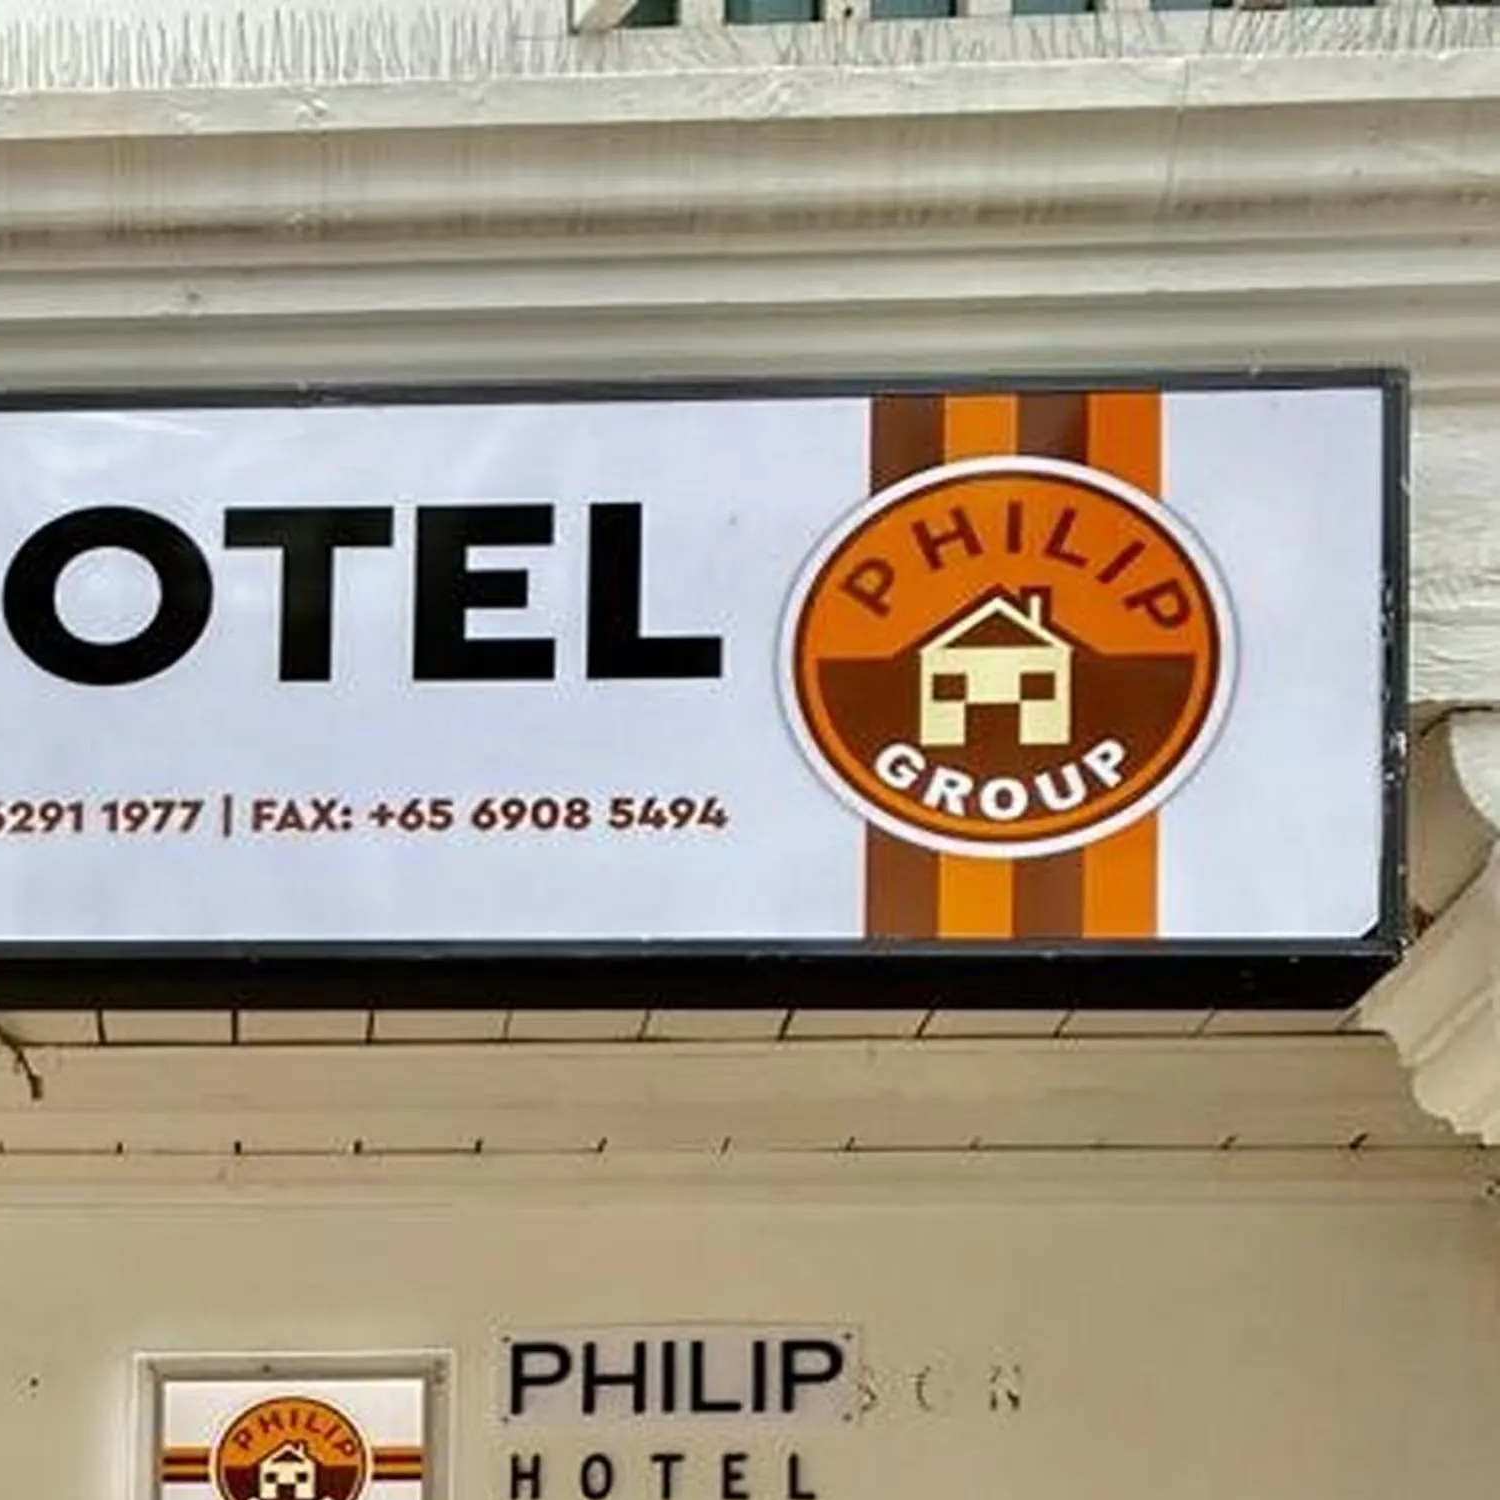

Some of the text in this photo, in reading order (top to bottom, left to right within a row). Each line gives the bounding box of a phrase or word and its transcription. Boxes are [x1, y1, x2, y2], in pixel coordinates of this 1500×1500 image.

[839, 501, 1192, 630] PHILIP
[100, 799, 205, 834] 1977
[251, 798, 353, 833] FAX:
[368, 798, 454, 832] +65
[470, 797, 592, 832] 6908
[607, 796, 729, 831] 5494
[873, 739, 1127, 820] GROUP
[509, 1339, 845, 1415] PHILIP
[233, 1409, 357, 1457] PHILIP
